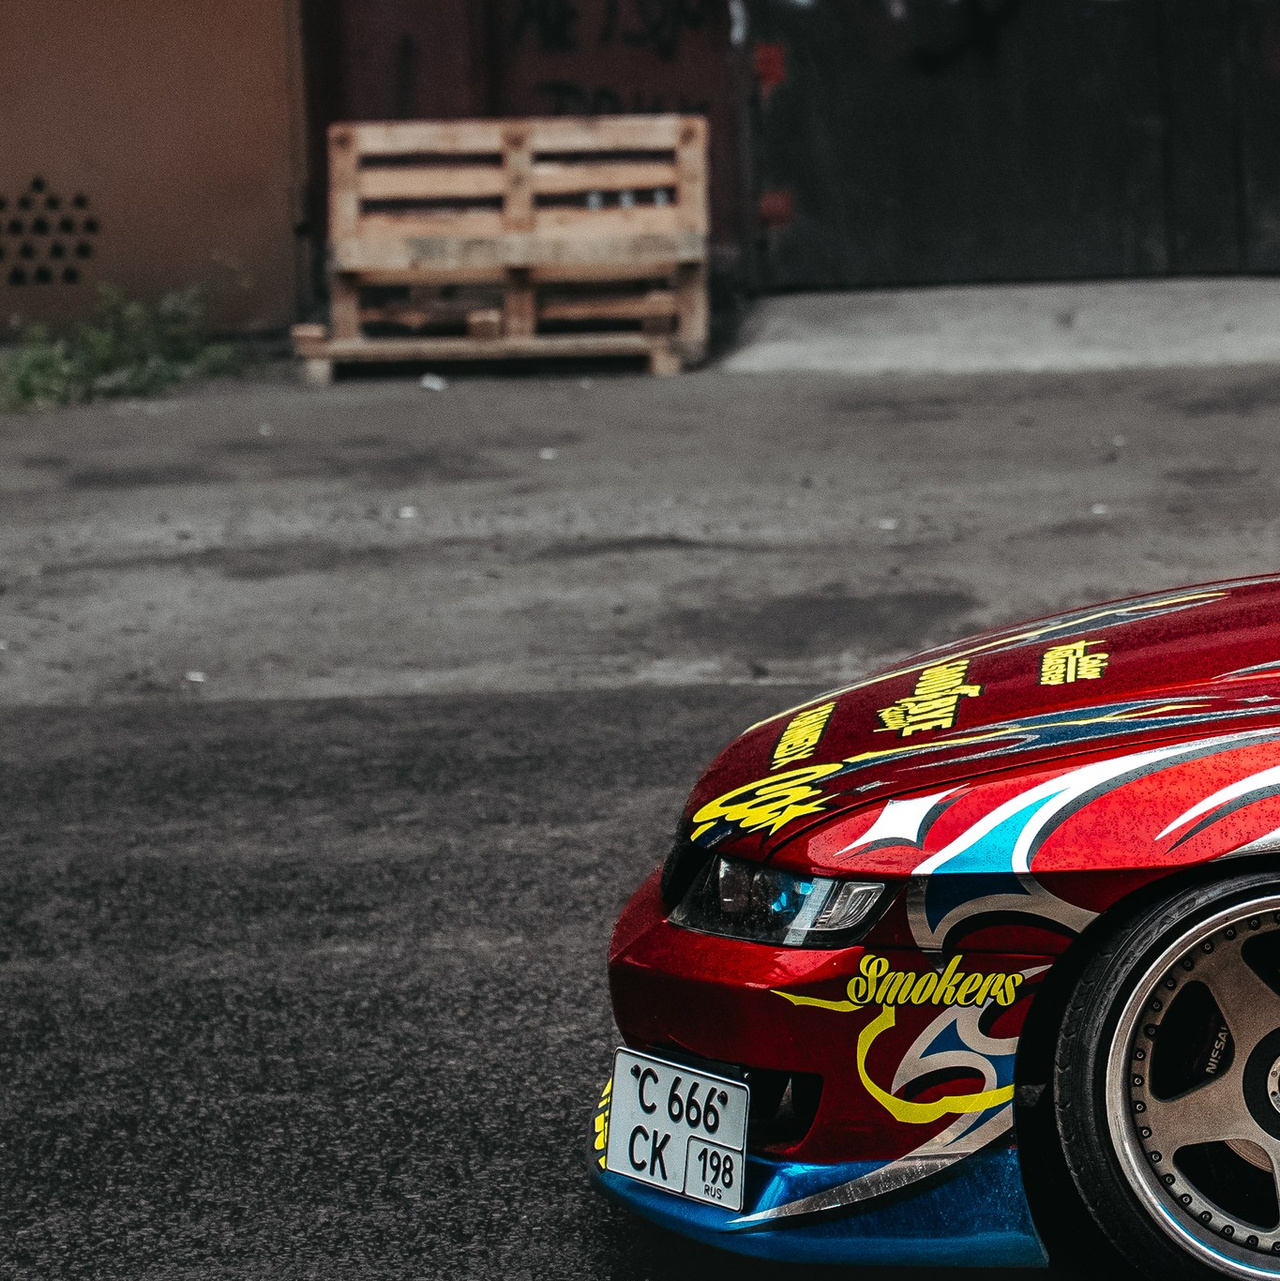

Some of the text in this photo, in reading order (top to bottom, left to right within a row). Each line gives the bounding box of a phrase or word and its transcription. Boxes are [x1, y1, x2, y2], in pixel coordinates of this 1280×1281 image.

[846, 954, 1024, 1007] Smokers
[667, 1076, 720, 1135] 666
[697, 1147, 734, 1189] 198
[703, 1184, 723, 1200] RUS
